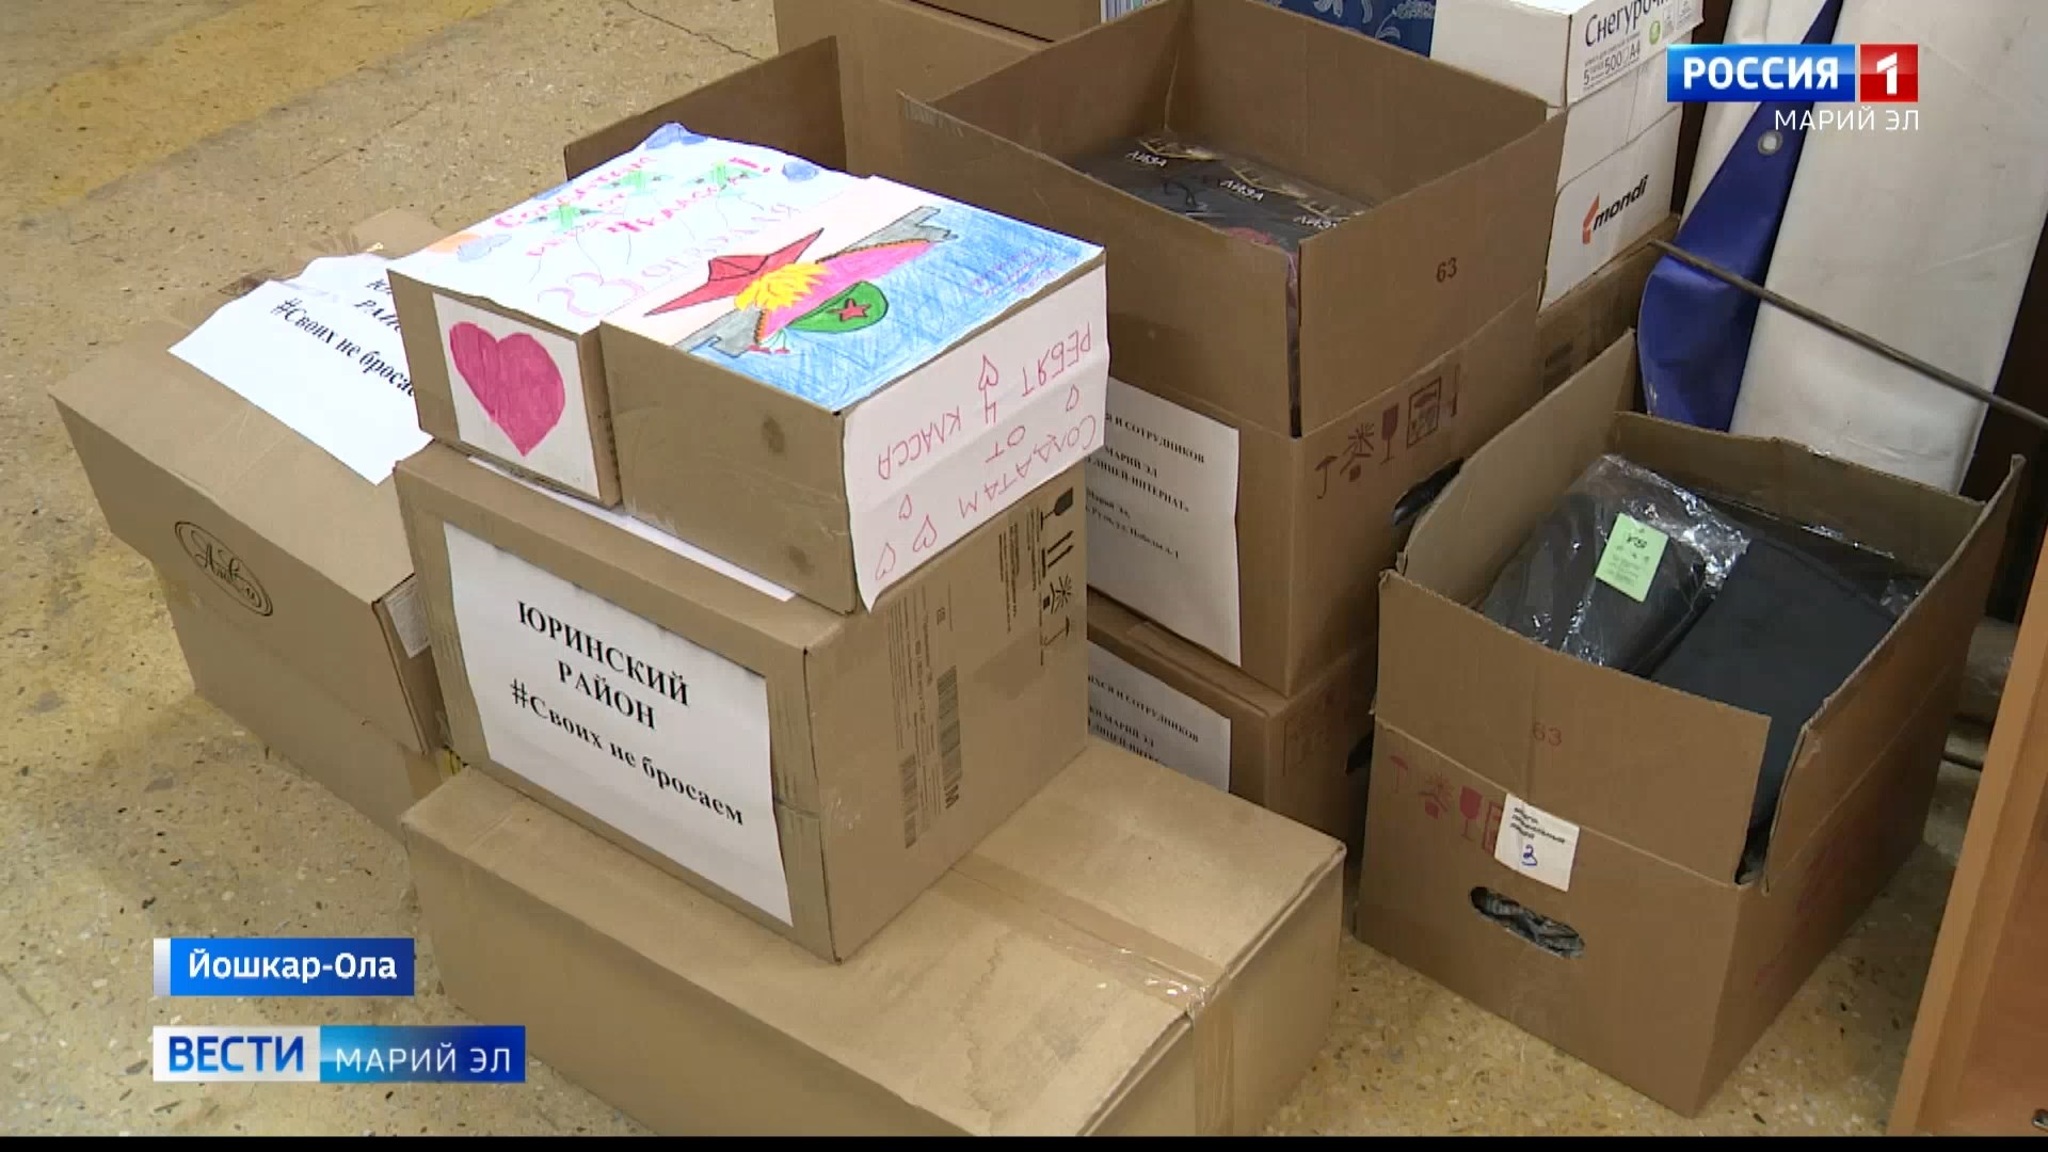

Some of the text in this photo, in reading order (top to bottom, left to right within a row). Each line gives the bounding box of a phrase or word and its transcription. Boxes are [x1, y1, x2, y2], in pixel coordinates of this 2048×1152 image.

[1604, 51, 1622, 75] 500
[1593, 174, 1649, 231] mondi
[1435, 257, 1458, 283] 63
[270, 297, 338, 345] #Своих
[335, 336, 362, 360] не
[1020, 321, 1092, 398] РЕБЯТ
[877, 404, 962, 481] КЛАССА
[957, 414, 1097, 519] СОЛДАТАМ
[984, 425, 1027, 464] ОТ
[1125, 420, 1205, 463] СОТРУДНИКОВ
[517, 600, 691, 707] ЮРИНСКИЙ
[557, 659, 657, 731] РАЙОН
[509, 678, 744, 826] #Своих не бросаем
[1532, 721, 1563, 747] 63
